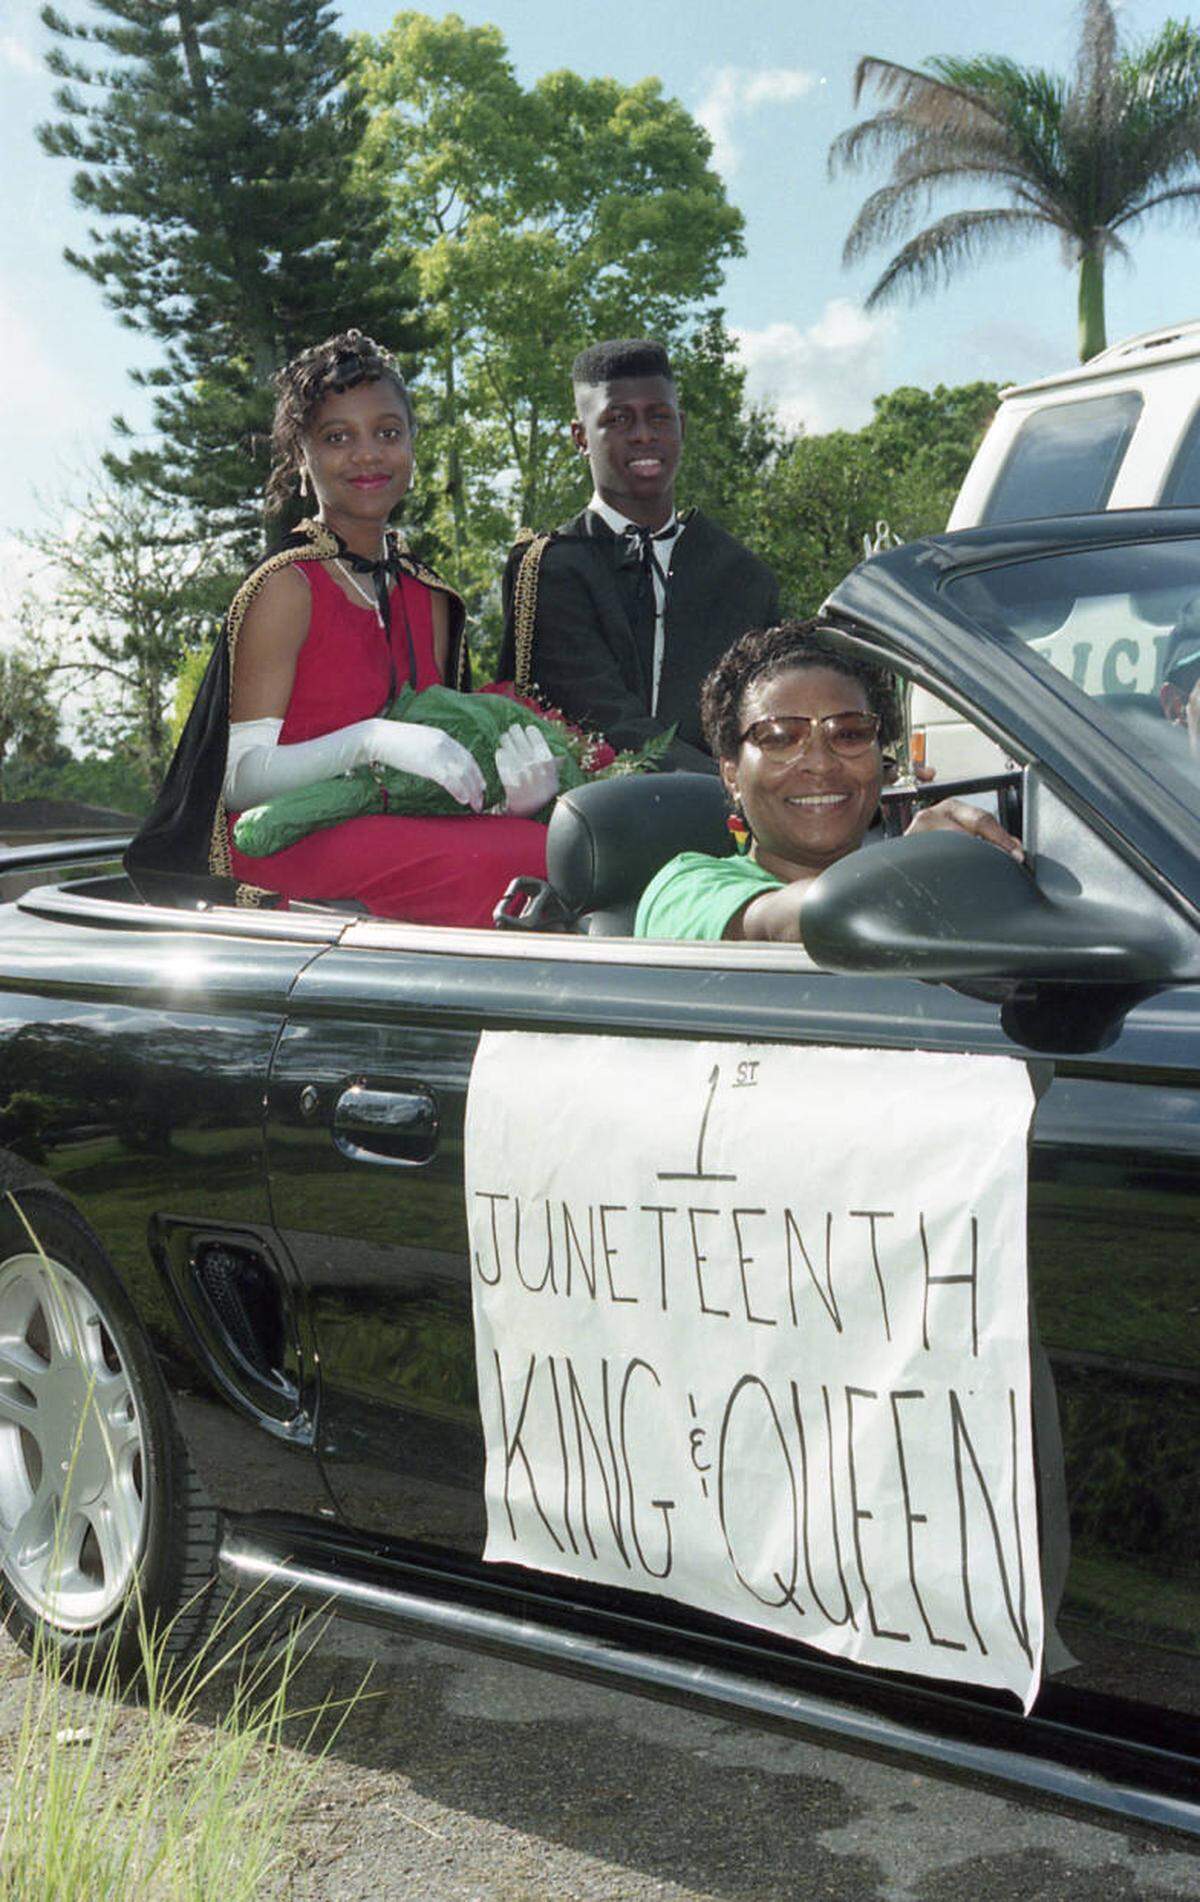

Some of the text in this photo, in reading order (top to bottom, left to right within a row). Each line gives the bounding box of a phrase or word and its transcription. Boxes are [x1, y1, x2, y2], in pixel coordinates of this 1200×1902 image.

[474, 1191, 979, 1357] JUNETEENTH
[493, 1348, 1035, 1670] KING & QUEEN
